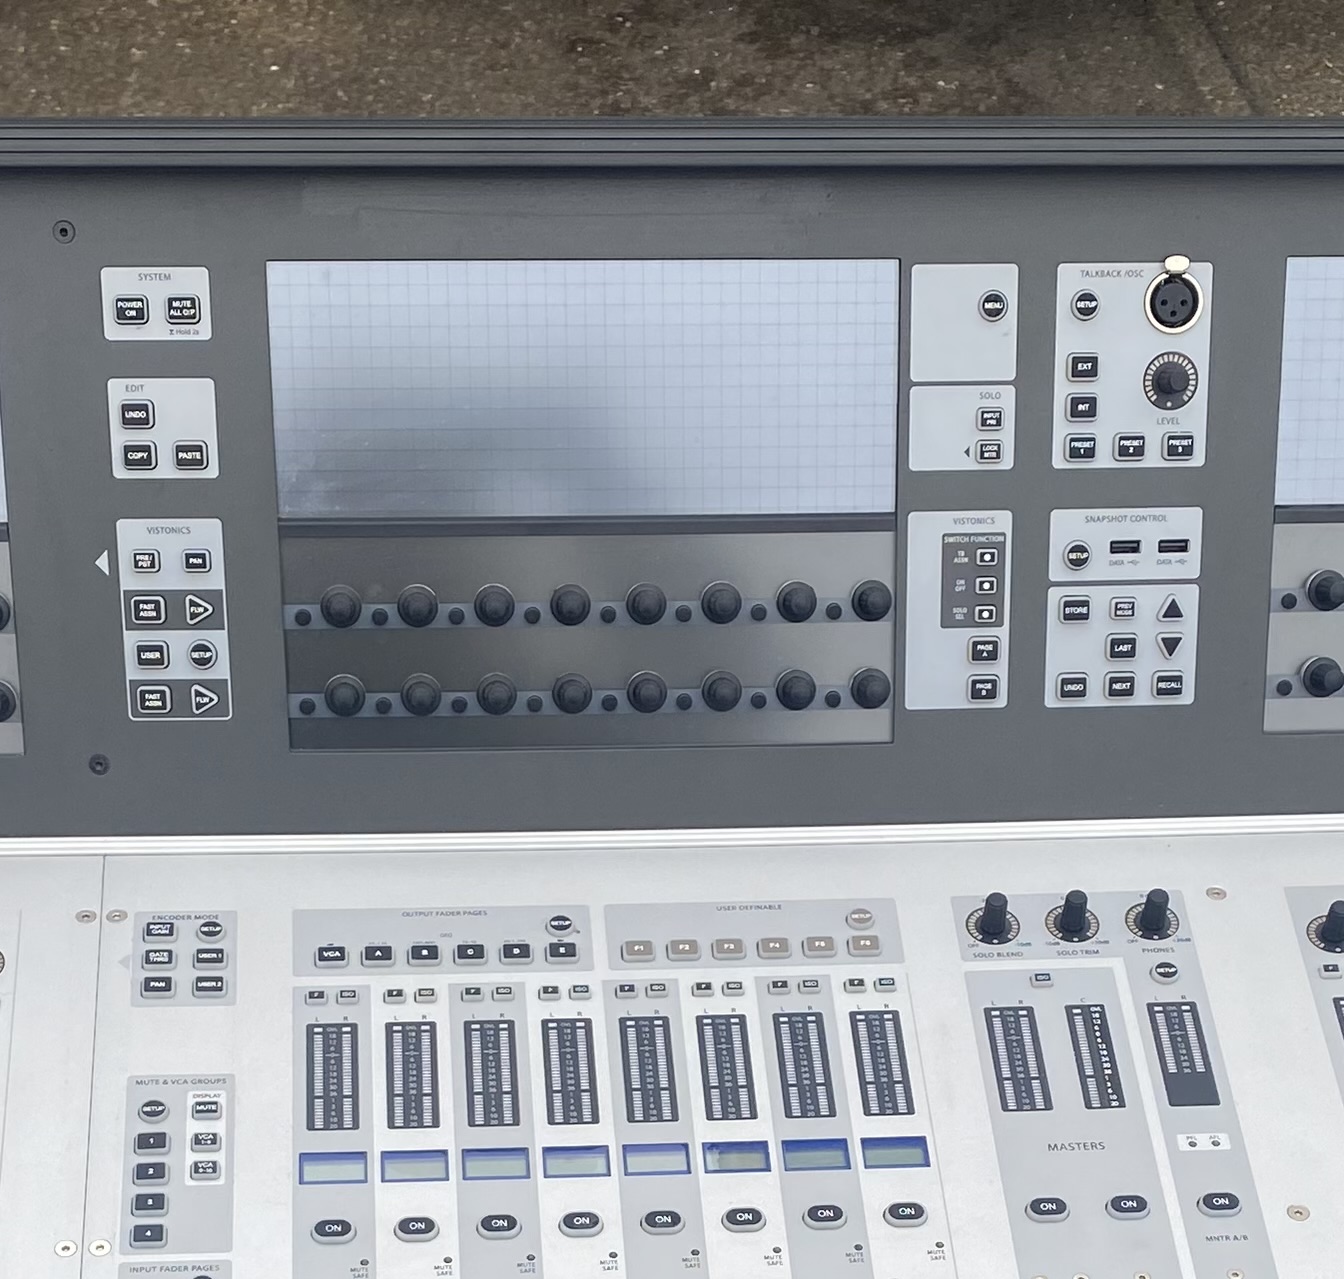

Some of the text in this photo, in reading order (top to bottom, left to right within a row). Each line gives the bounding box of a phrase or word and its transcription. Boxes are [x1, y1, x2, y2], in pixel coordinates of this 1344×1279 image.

[979, 392, 1001, 400] SOLO
[1085, 515, 1128, 523] SNAPSHOT
[1048, 1141, 1105, 1151] MASTERS
[1121, 1200, 1137, 1208] ON
[1213, 1197, 1229, 1206] ON
[1040, 1202, 1056, 1211] ON
[899, 1207, 915, 1215] ON
[491, 1219, 507, 1227] ON
[655, 1215, 671, 1223] ON
[326, 1224, 341, 1232] ON
[409, 1221, 425, 1230] ON
